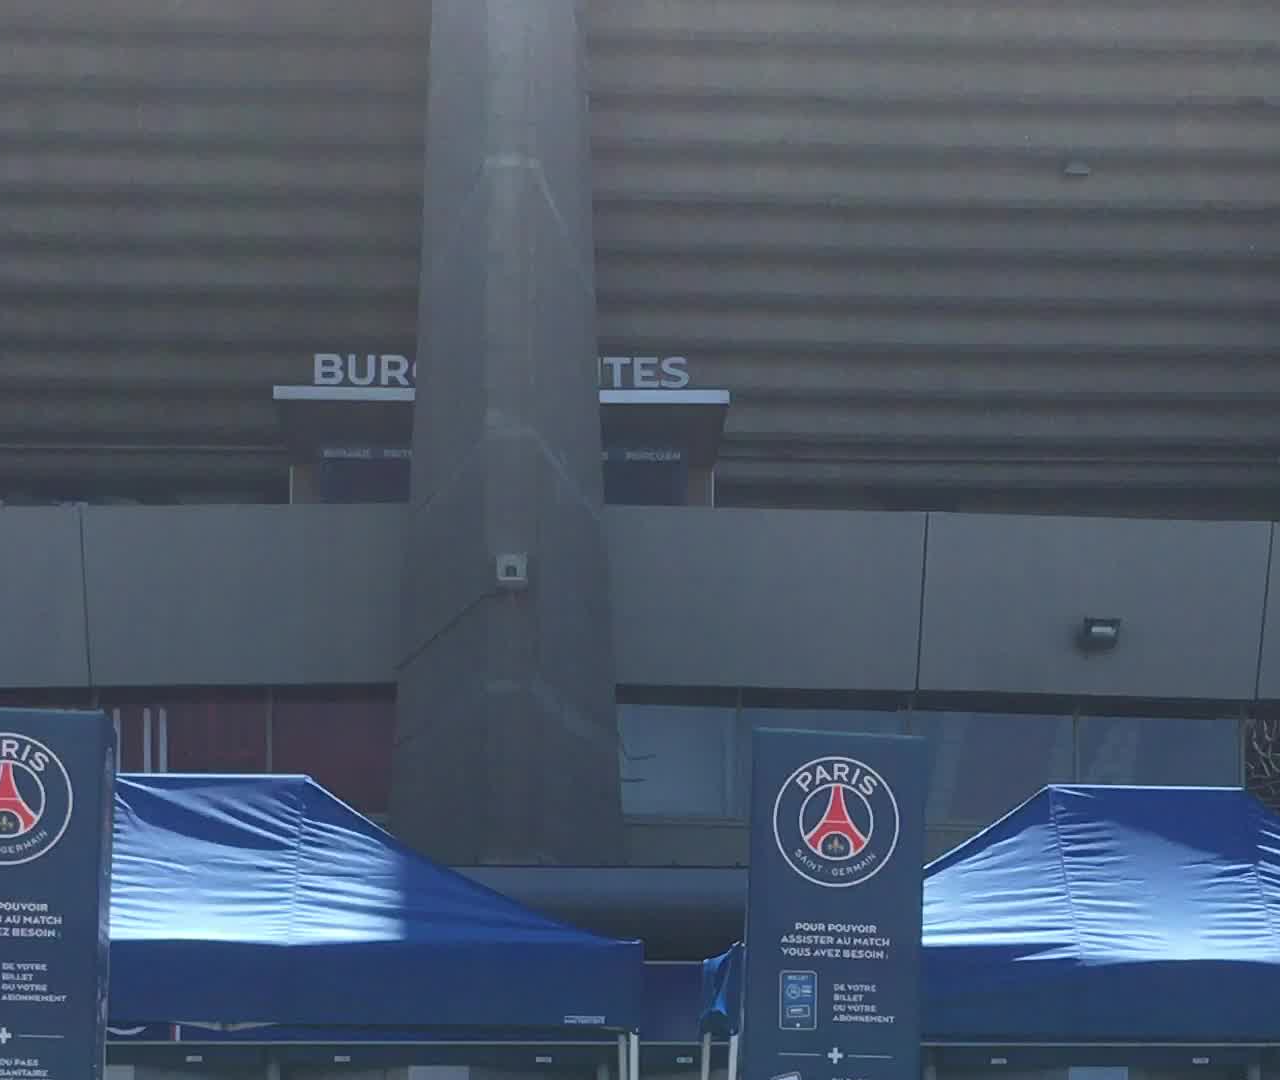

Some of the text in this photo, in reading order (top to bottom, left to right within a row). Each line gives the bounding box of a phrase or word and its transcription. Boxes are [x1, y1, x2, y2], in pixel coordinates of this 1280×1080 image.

[313, 353, 417, 386] BUR
[795, 763, 878, 796] PARIS
[0, 829, 48, 854] GERMAIN
[794, 849, 877, 876] SAINT GERMAIN
[4, 914, 21, 924] AU
[22, 915, 63, 925] MATCH
[11, 927, 56, 937] BESOIN
[795, 922, 877, 934] POUR POUVOIR
[780, 935, 890, 947] ASSISTER AU MATCH
[781, 947, 884, 959] VOUS AVEZ BESOIN
